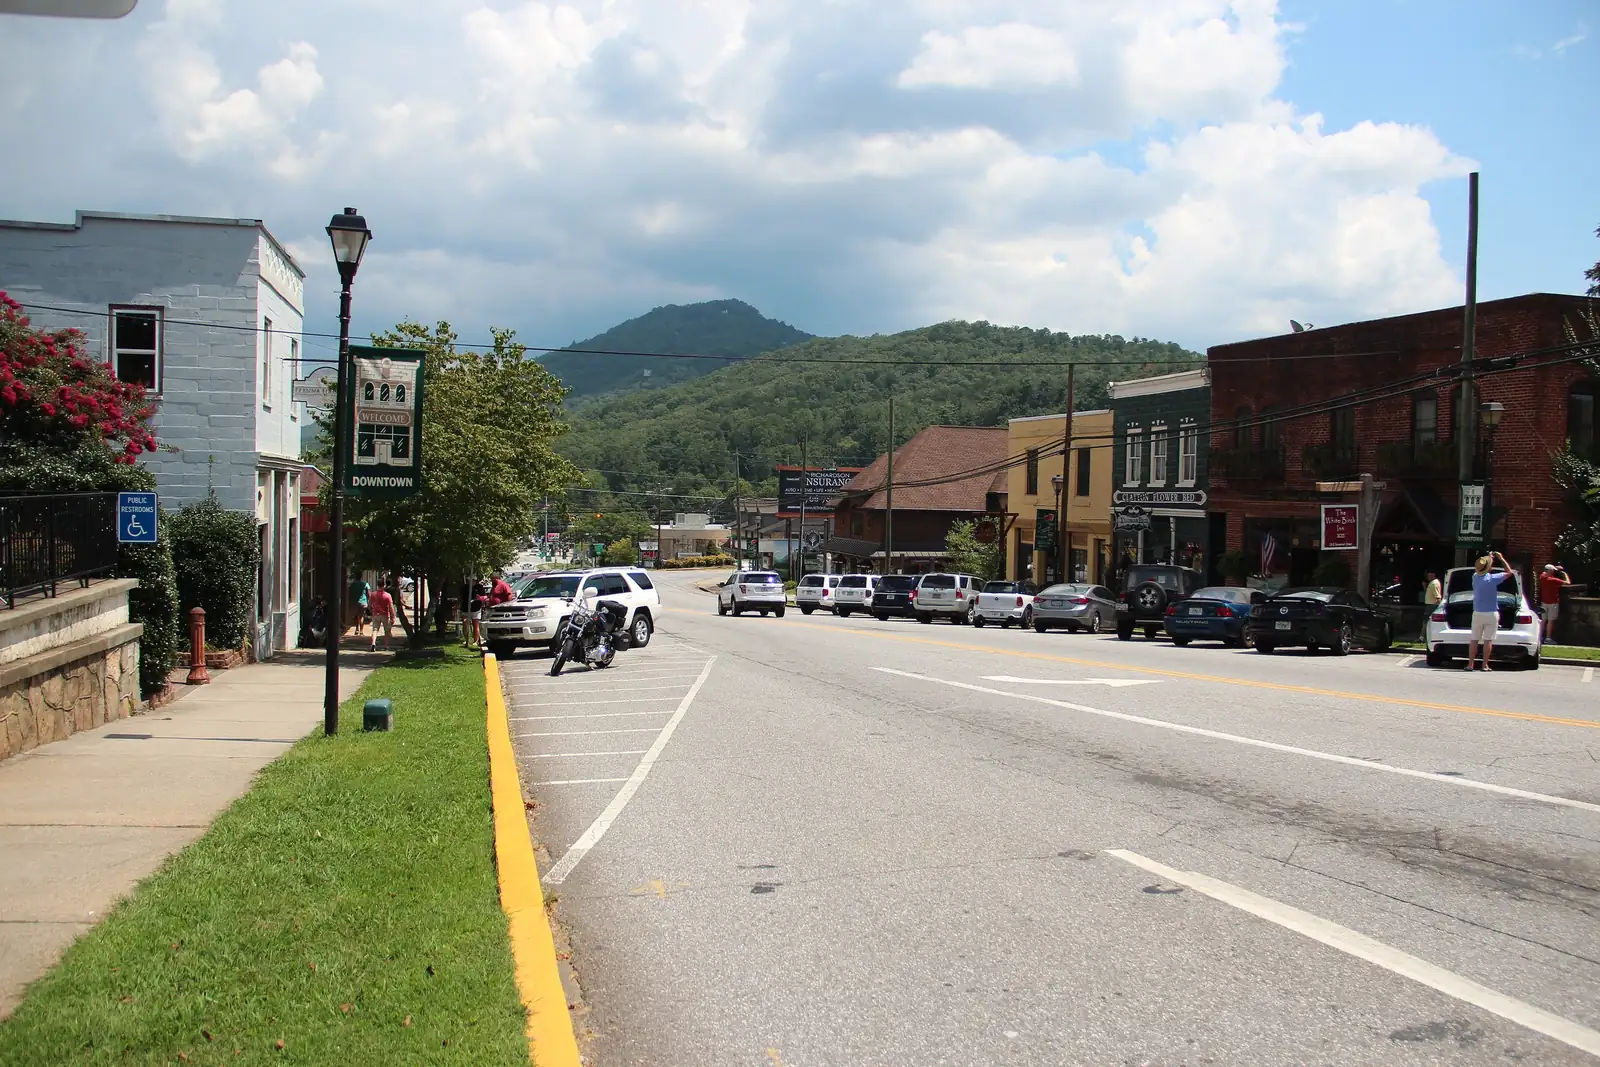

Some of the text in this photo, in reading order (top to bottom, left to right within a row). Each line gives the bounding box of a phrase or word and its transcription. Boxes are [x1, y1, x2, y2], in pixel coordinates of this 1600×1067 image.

[362, 411, 406, 423] WELCOME
[352, 476, 413, 487] DOWNTOWN
[127, 496, 148, 504] PUBLIC
[1153, 493, 1178, 502] FLOWER
[1182, 493, 1195, 502] BED
[1335, 508, 1346, 516] The
[1325, 516, 1356, 525] White Birch
